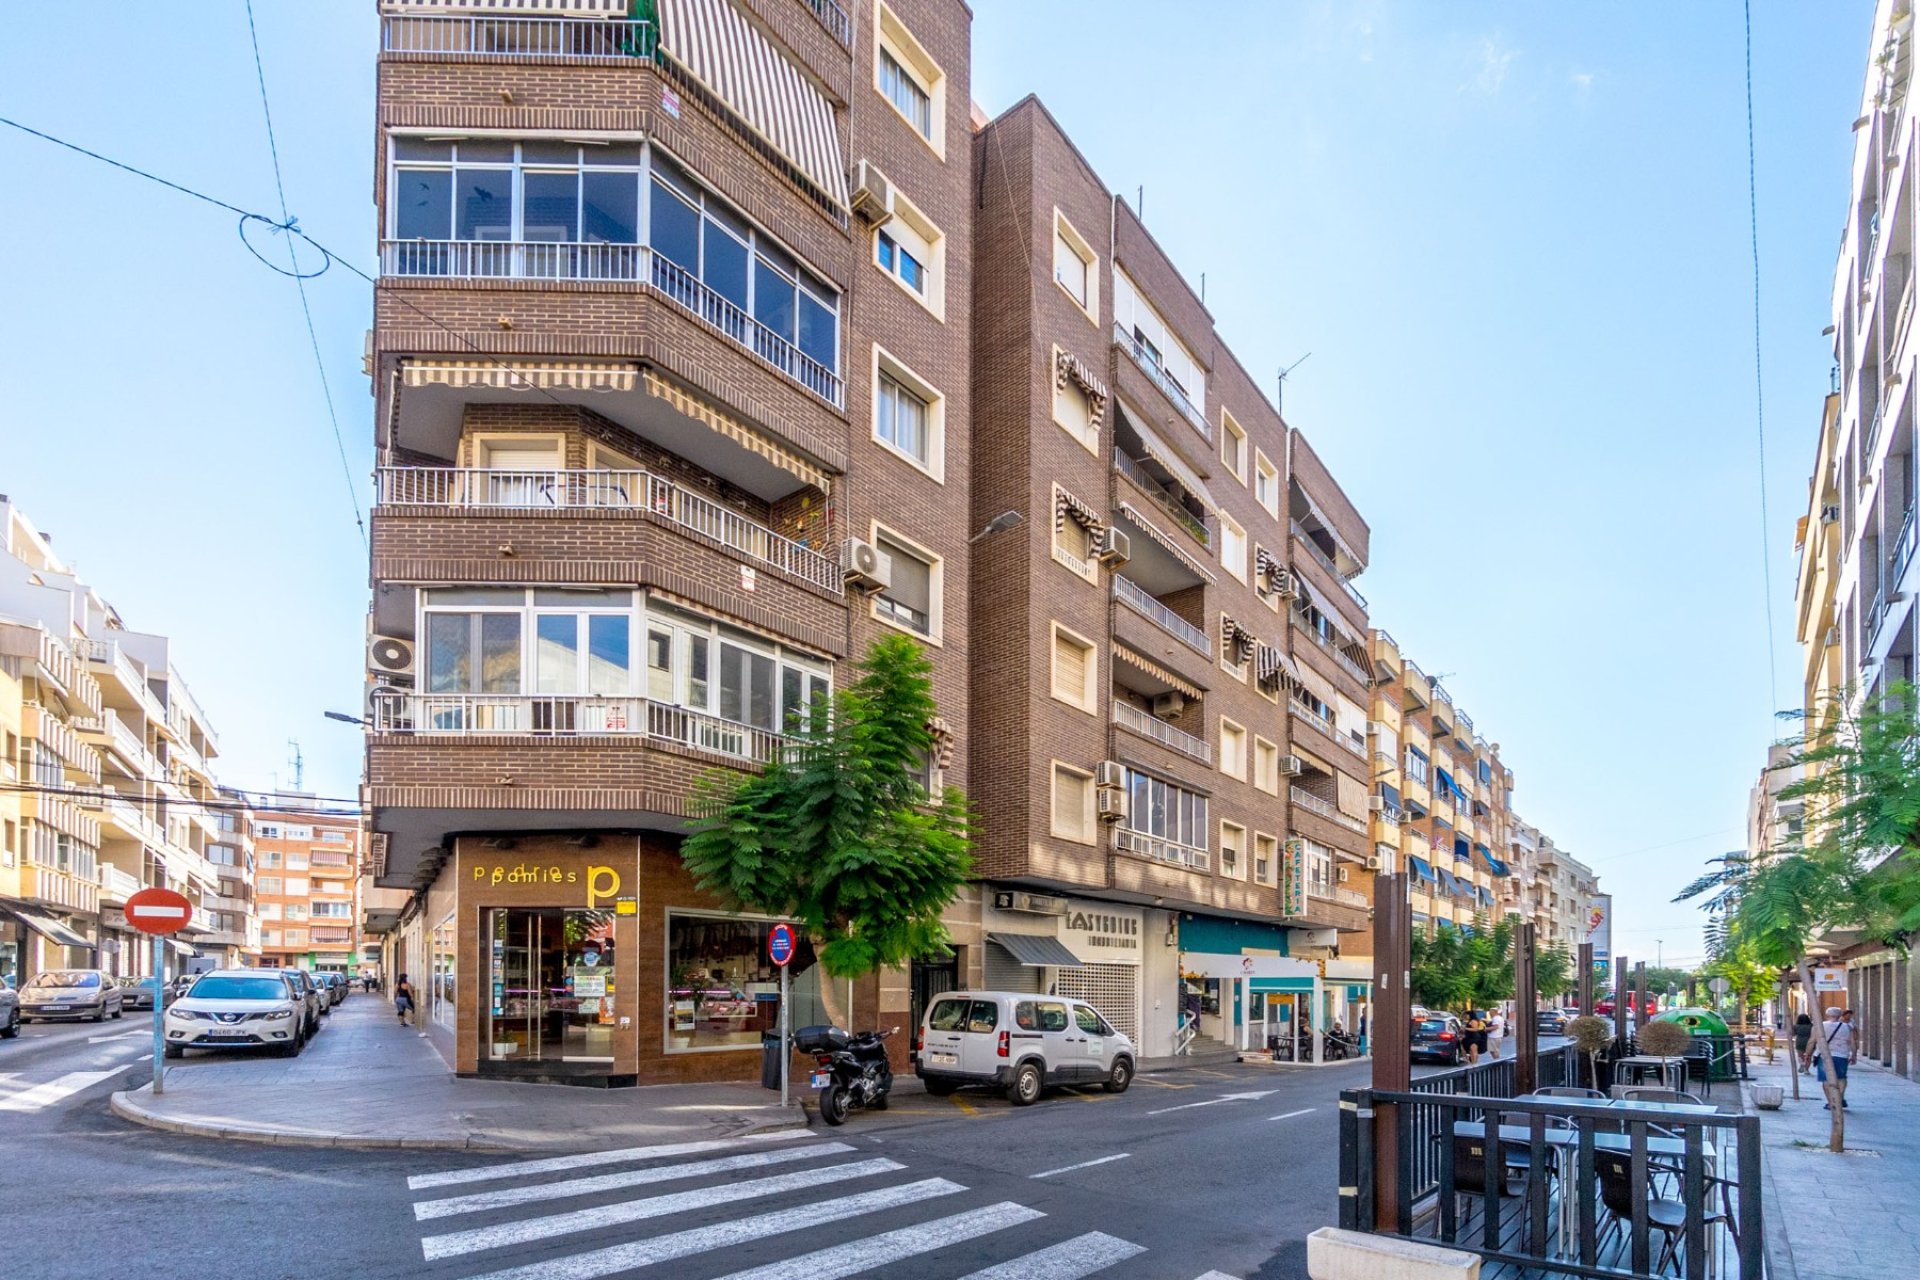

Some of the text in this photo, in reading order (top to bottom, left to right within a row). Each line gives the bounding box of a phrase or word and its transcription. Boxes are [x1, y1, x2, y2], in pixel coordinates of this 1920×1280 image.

[473, 862, 561, 882] pedro
[491, 868, 578, 887] pamies
[1293, 843, 1302, 913] CAFETERIA
